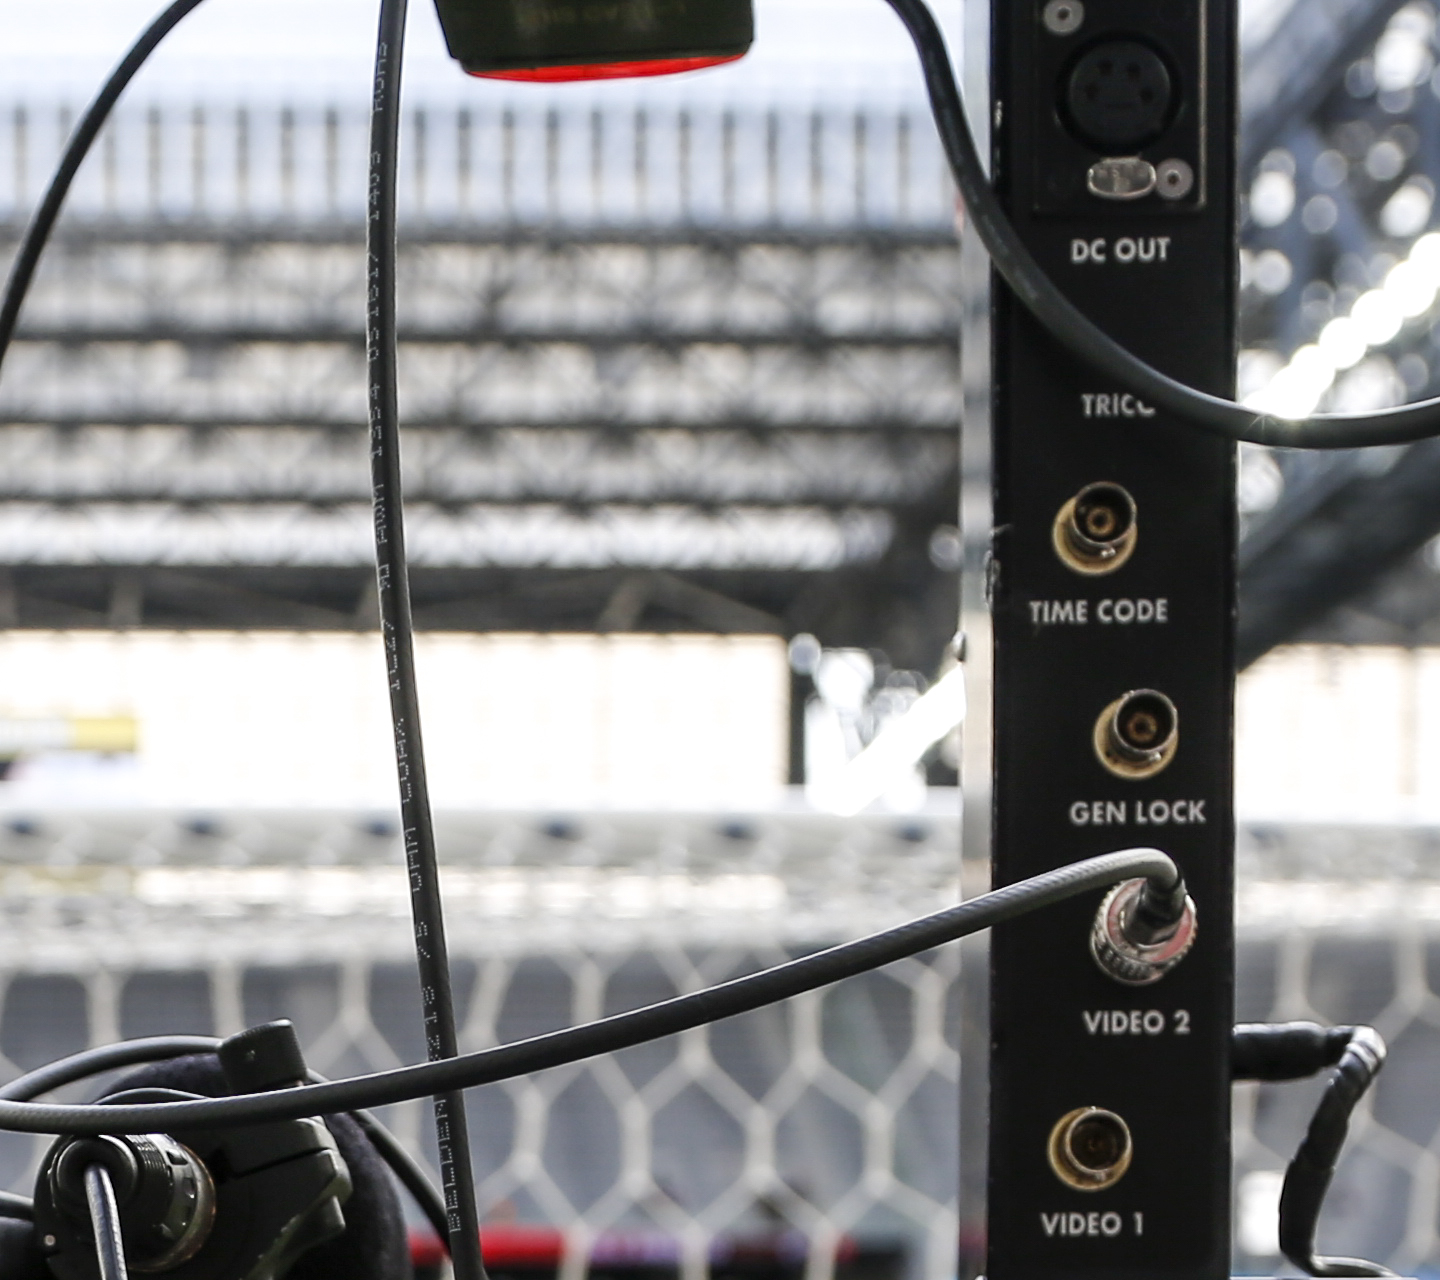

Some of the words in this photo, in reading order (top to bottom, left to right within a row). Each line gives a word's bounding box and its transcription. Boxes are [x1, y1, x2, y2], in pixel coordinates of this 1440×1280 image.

[1071, 238, 1106, 264] DC
[1115, 236, 1170, 263] OUT
[1030, 599, 1087, 624] TIME
[1097, 598, 1168, 623] CODE
[1070, 801, 1127, 825] GEN
[1135, 800, 1206, 824] LOCK
[1083, 1010, 1165, 1035] VIDEO
[1173, 1010, 1191, 1034] 2
[1041, 1212, 1122, 1236] VIDEO
[1133, 1212, 1144, 1236] 1
